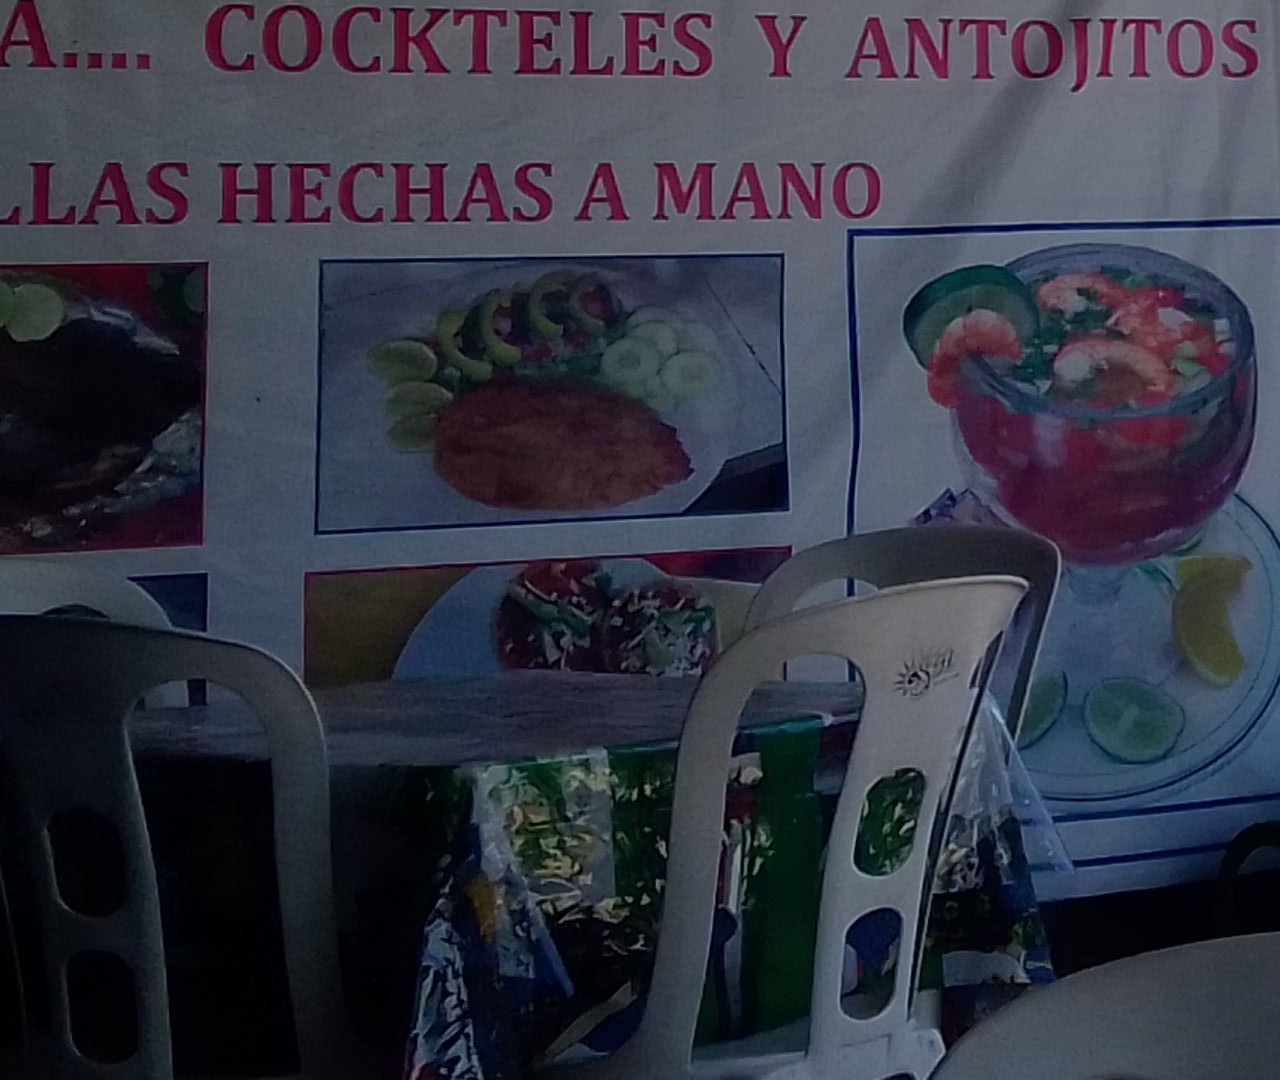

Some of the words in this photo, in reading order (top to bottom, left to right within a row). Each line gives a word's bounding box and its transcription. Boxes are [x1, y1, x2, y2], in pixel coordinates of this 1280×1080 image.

[755, 14, 807, 79] Y
[845, 17, 1259, 92] ANTOJITOS
[217, 162, 553, 224] HECHAS
[577, 162, 629, 222] A
[653, 162, 881, 221] MANO
